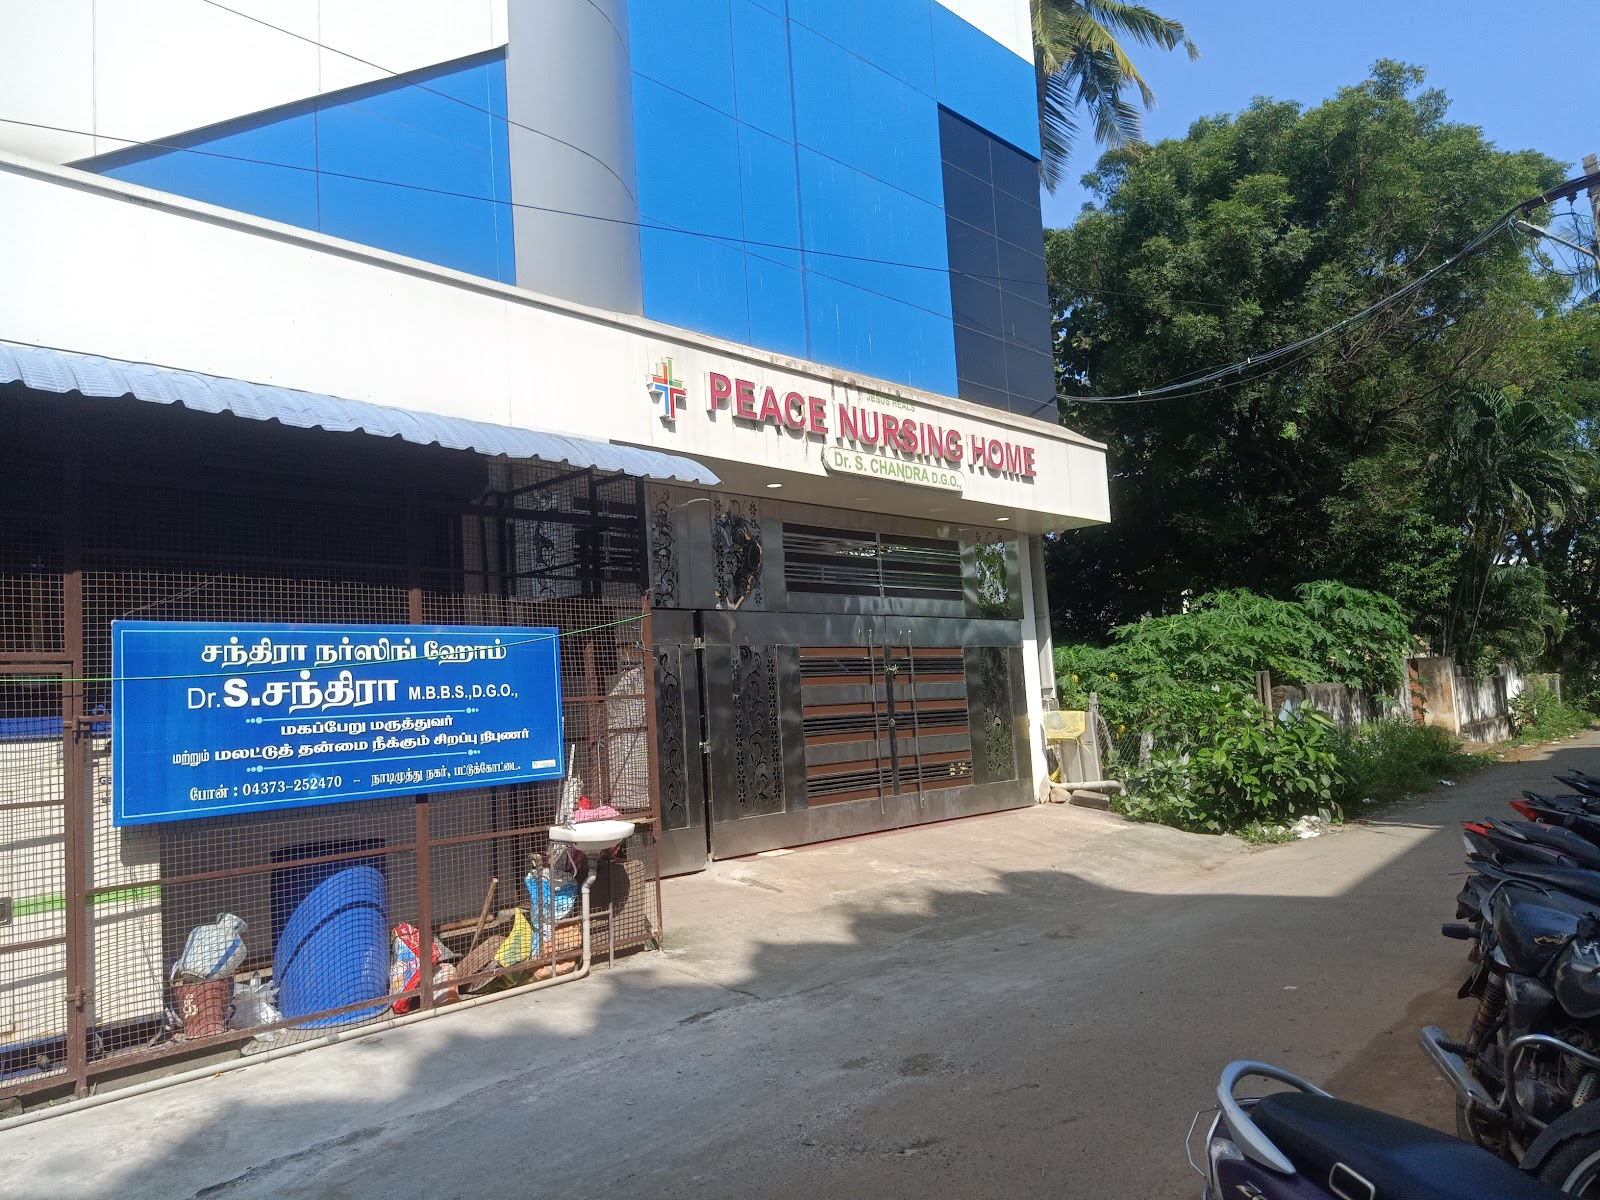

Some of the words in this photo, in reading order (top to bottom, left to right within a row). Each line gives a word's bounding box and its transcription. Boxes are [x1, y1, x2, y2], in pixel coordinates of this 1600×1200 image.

[708, 371, 828, 434] PEACE
[837, 403, 964, 462] NURSING
[970, 434, 1037, 477] HOME
[834, 451, 852, 469] Dr.
[854, 455, 867, 471] S.
[870, 459, 930, 483] CHANDRA
[201, 636, 308, 669] சந்திரா
[314, 636, 417, 667] நர்ஸிங்
[423, 638, 507, 666] ஹோம்
[280, 720, 366, 736] மகப்பேறு
[370, 715, 454, 733] மருத்துவர்
[172, 749, 210, 767] மற்றும்
[214, 743, 294, 761] மலட்டுத்
[297, 740, 368, 759] தன்மை
[372, 734, 430, 753] நீக்கும்
[433, 732, 477, 747] சிறப்பு
[480, 728, 530, 745] நிபுணர்
[189, 784, 230, 801] போன்
[242, 775, 342, 796] 04373-252470
[371, 767, 423, 787] நாடிமுத்து
[425, 764, 451, 781] நகர்,
[454, 761, 521, 777] பட்டுக்கோட்டை.
